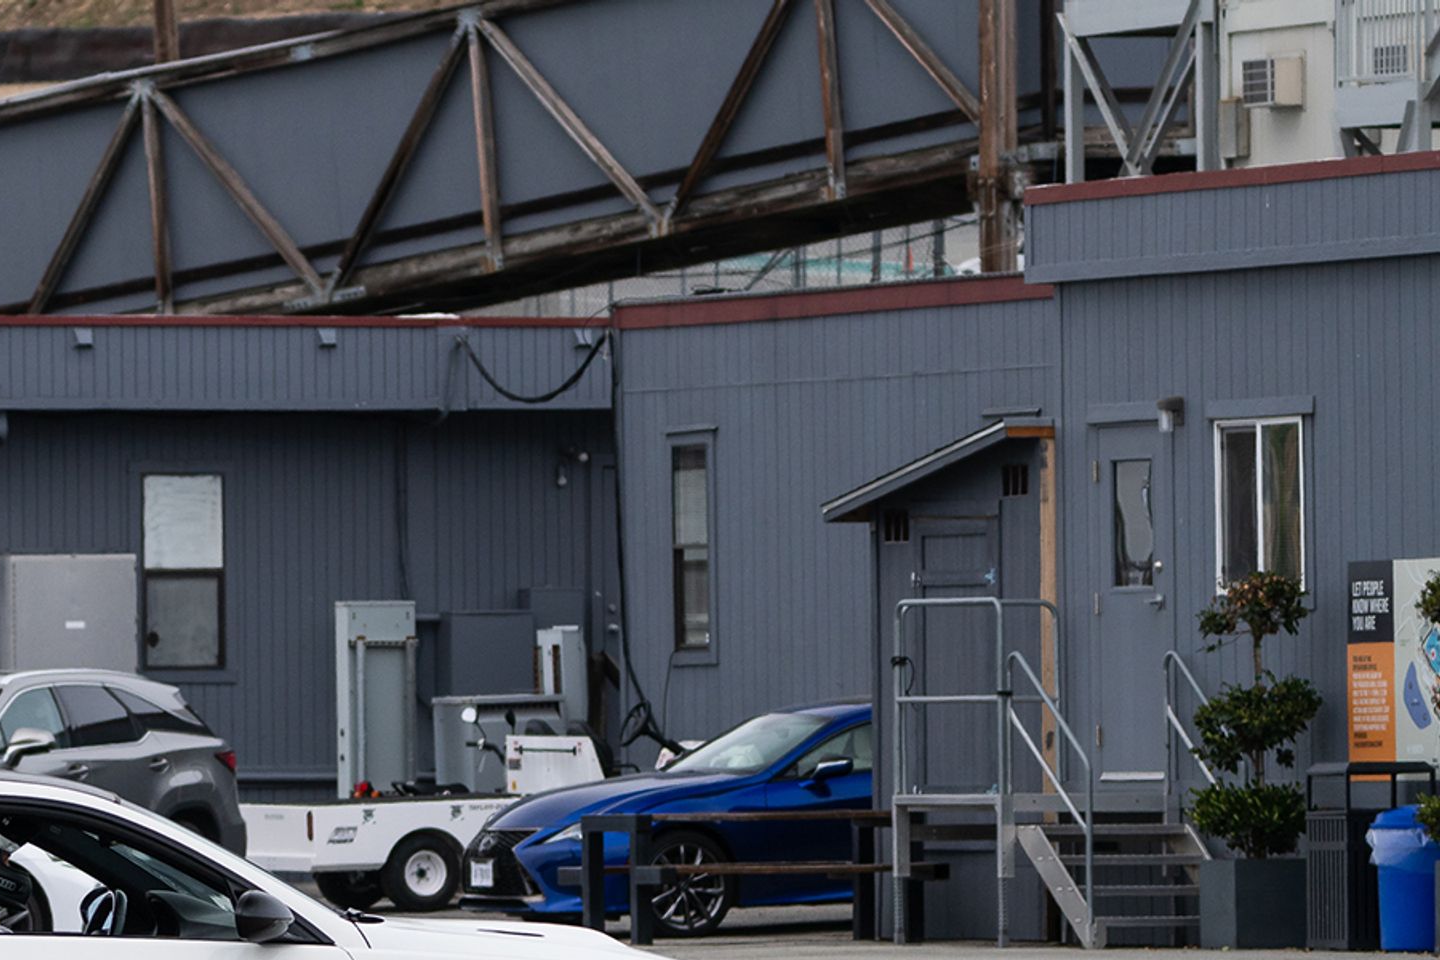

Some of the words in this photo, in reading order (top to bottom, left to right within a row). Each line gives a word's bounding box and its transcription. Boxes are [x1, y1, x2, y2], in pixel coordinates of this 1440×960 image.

[1352, 581, 1362, 597] LET
[1363, 580, 1384, 596] PEOPLE
[1352, 598, 1369, 614] KNOW
[1370, 597, 1389, 613] WHERE
[1352, 615, 1364, 631] YOU
[1364, 615, 1376, 630] ARE
